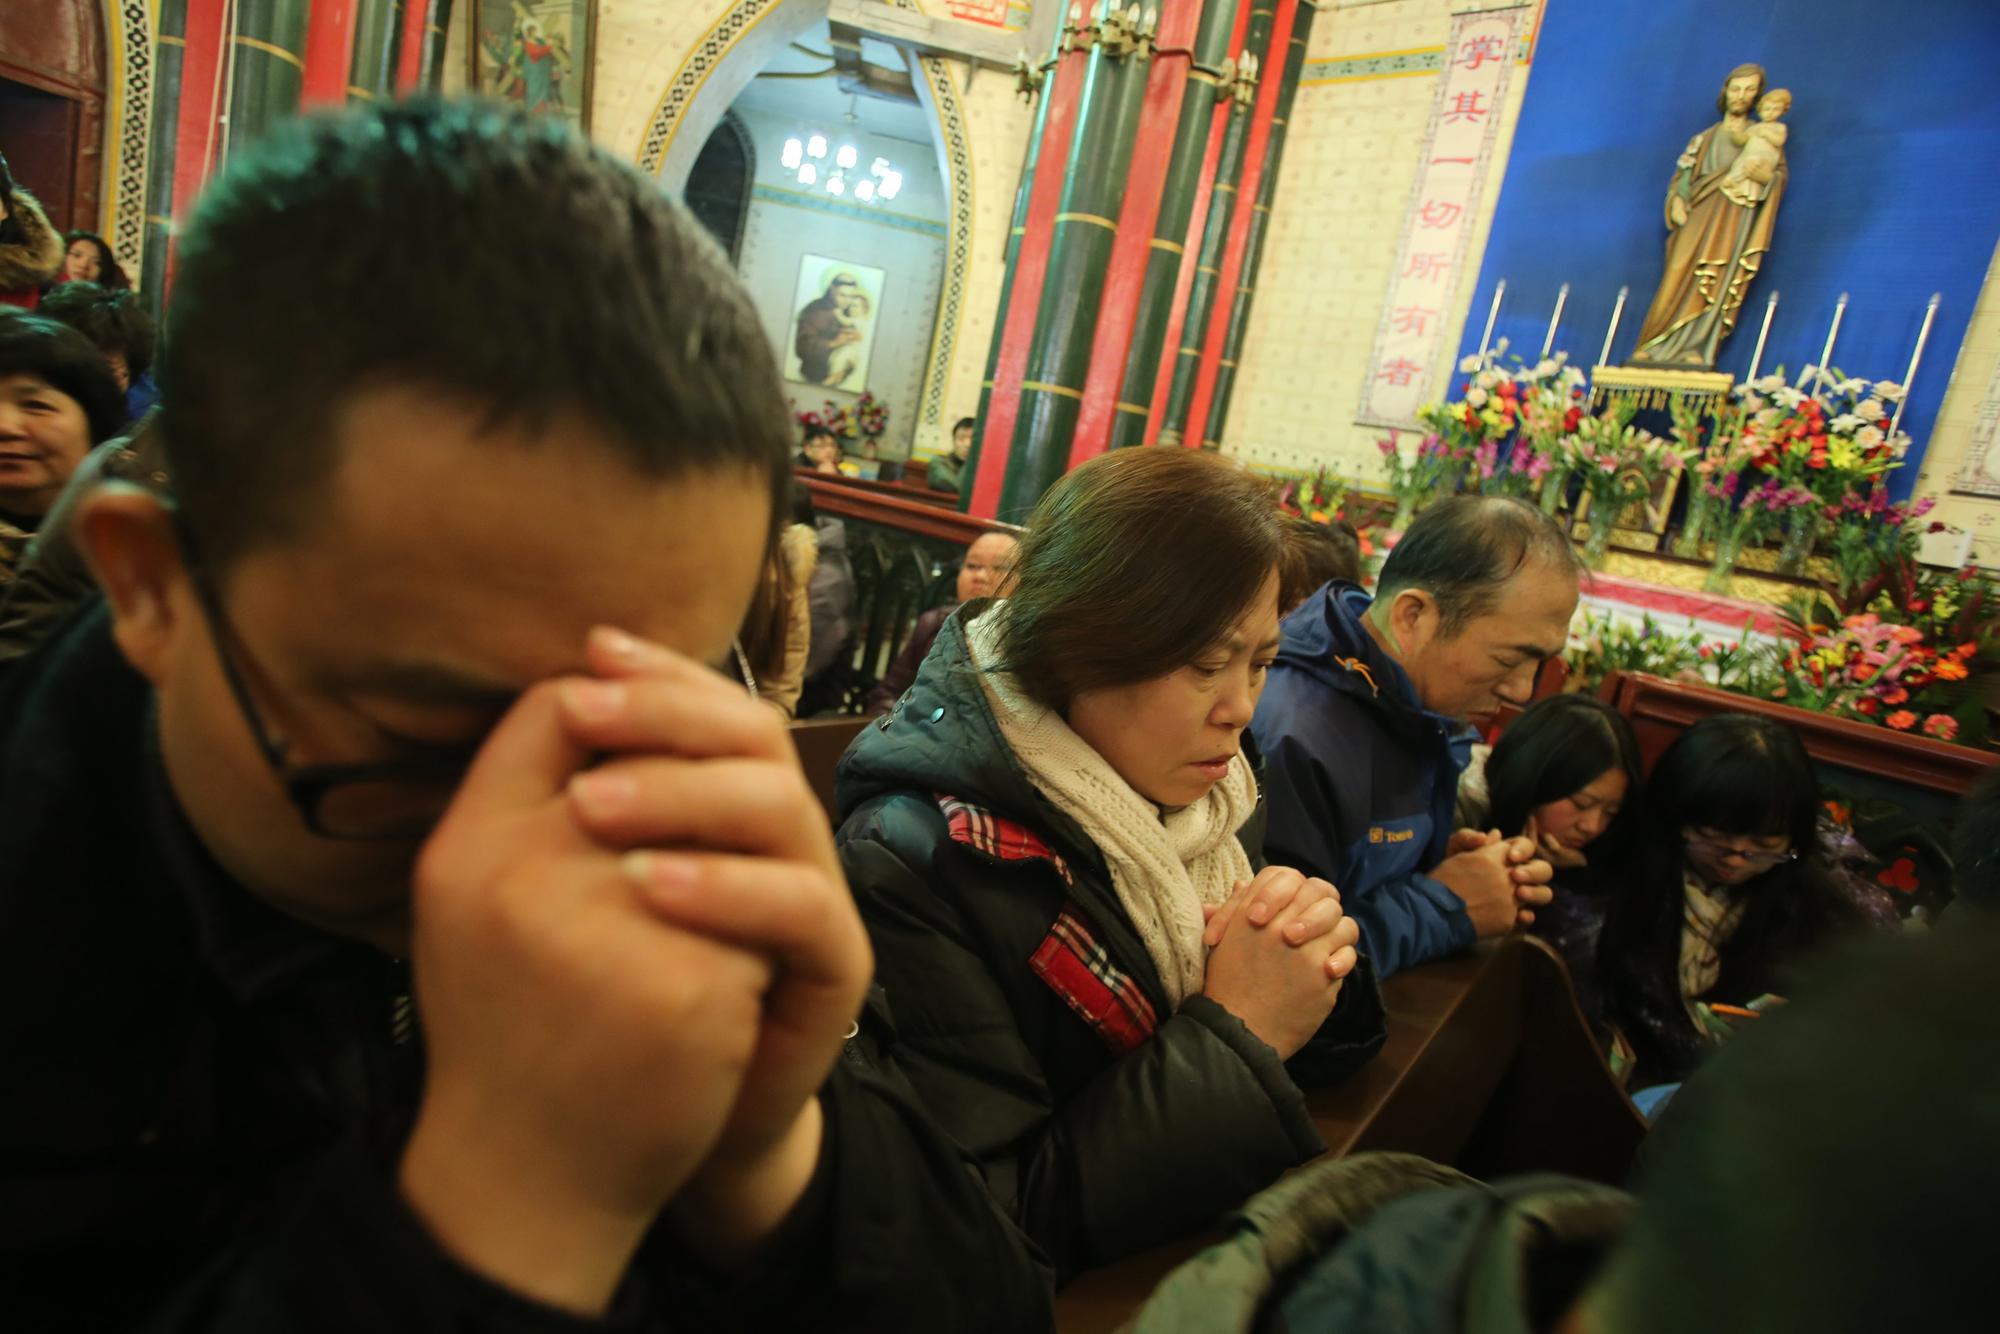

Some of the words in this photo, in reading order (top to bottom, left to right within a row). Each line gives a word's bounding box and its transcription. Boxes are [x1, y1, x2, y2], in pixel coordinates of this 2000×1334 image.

[1376, 35, 1503, 387] 掌其一切所有者
